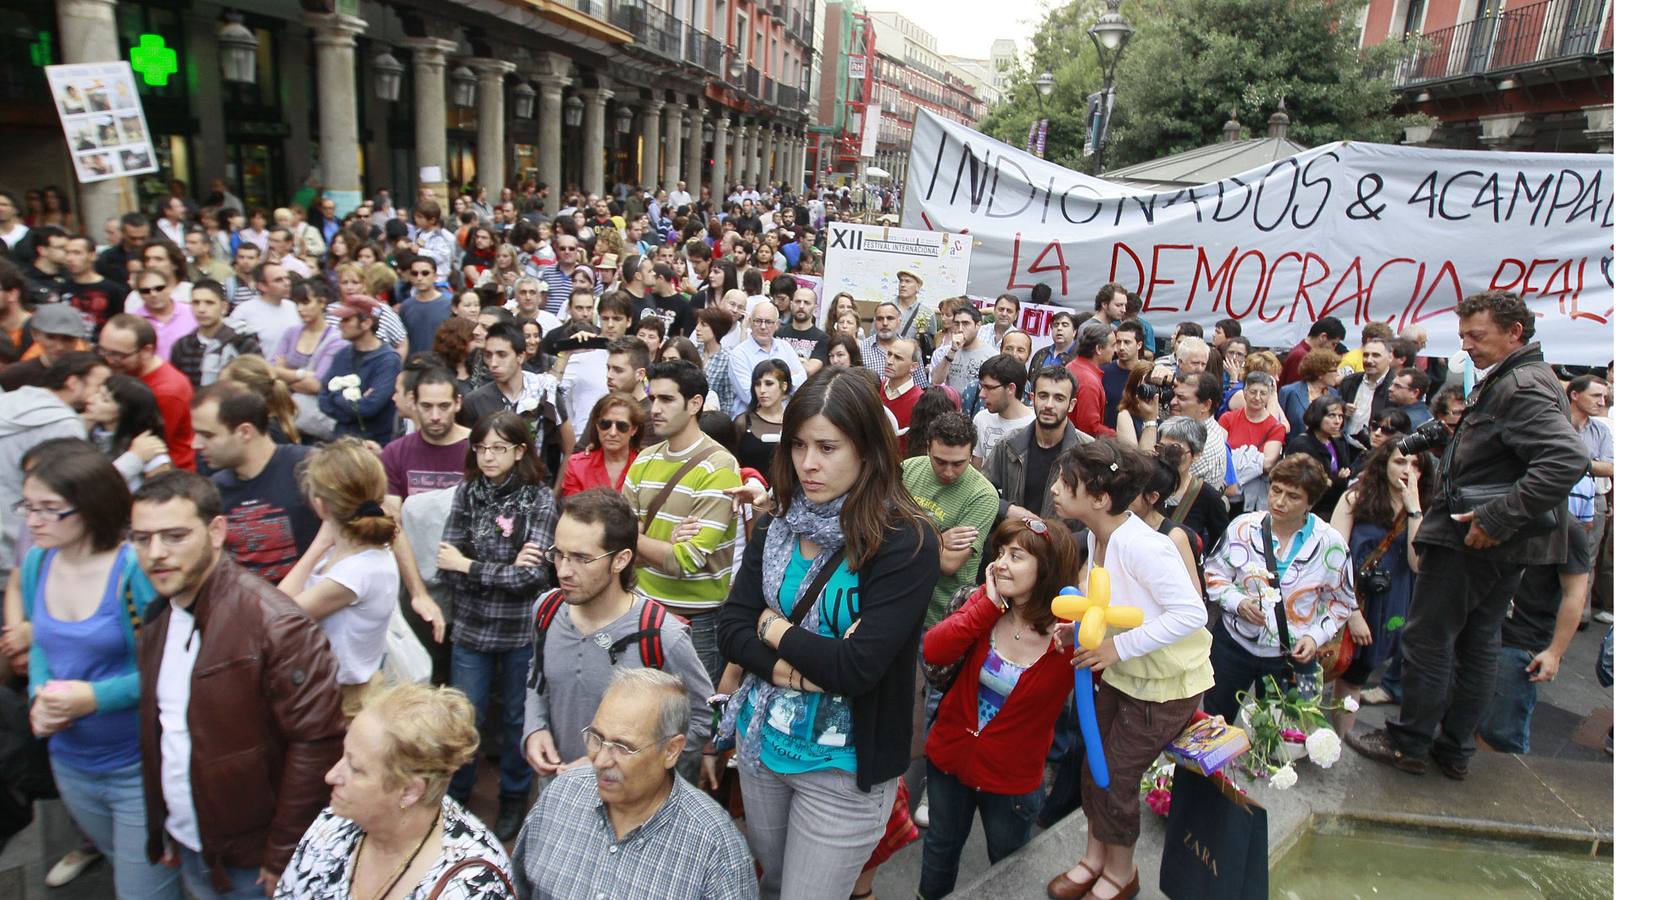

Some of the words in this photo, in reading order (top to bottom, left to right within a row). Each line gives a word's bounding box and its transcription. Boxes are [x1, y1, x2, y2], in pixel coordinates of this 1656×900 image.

[1345, 172, 1387, 221] &
[830, 227, 863, 251] XII
[863, 240, 892, 249] FESTIVAL
[892, 243, 939, 255] INTERNACIONAL
[1006, 231, 1071, 296] LA
[1108, 240, 1464, 336] DEMOCRACIA
[1183, 830, 1219, 878] ZARA
